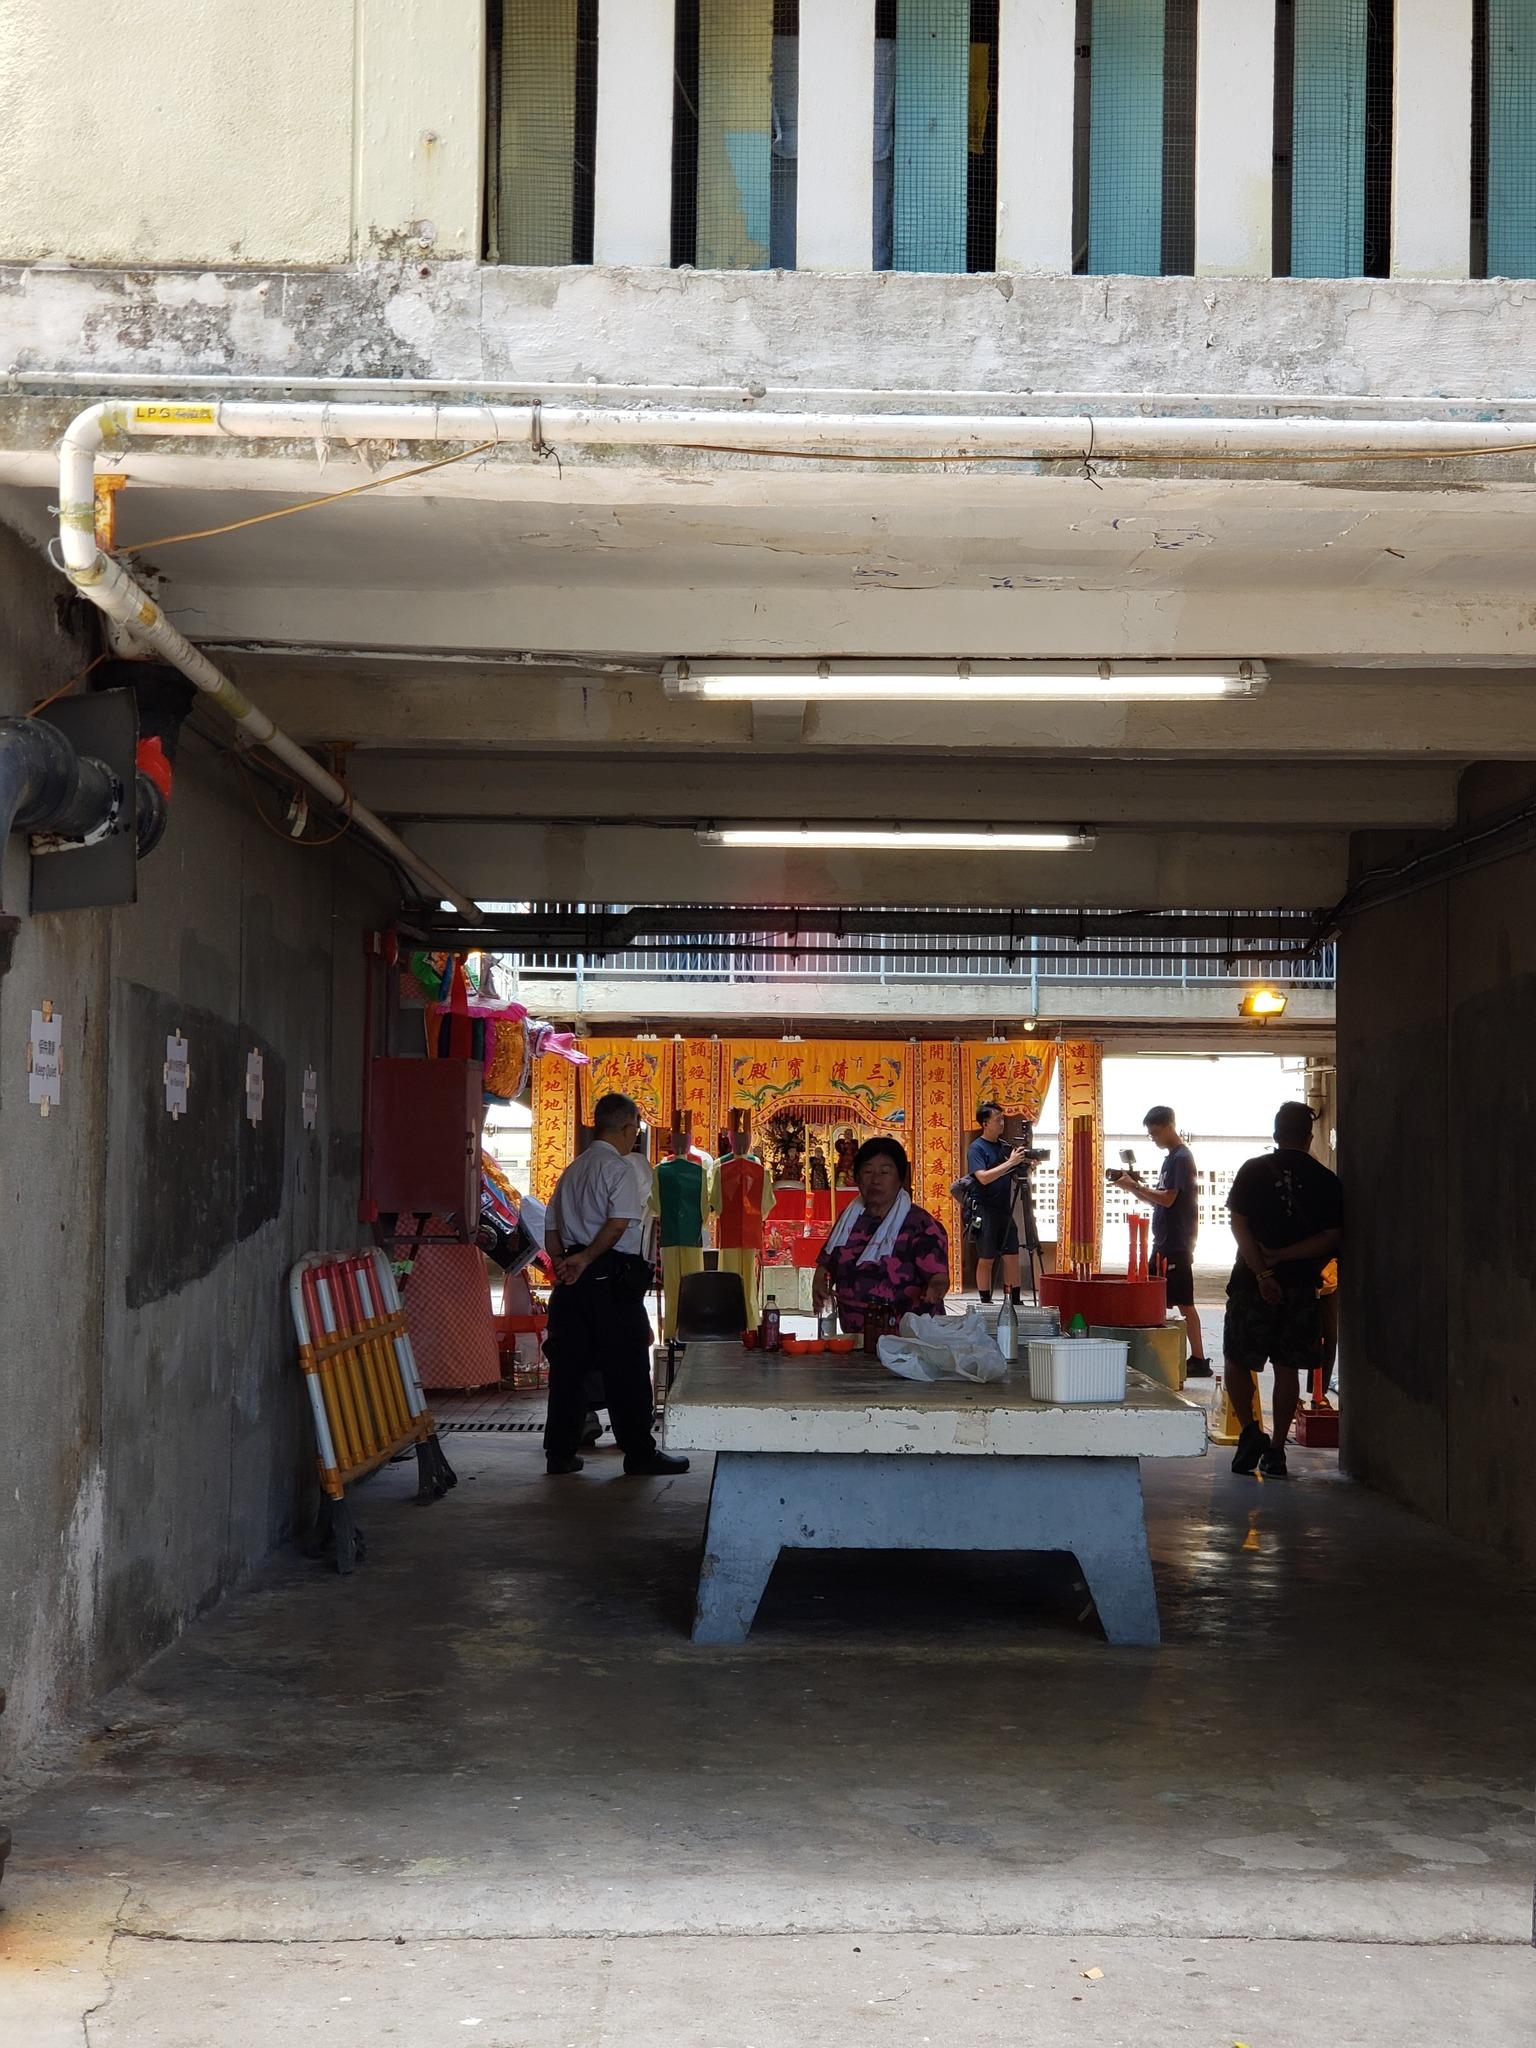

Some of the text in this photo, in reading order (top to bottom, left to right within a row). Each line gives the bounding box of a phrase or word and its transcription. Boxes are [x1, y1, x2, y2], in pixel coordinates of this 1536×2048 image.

[136, 407, 170, 418] LPG
[1071, 1043, 1091, 1107] 道生一一
[542, 1060, 563, 1206] 法地地法天天法
